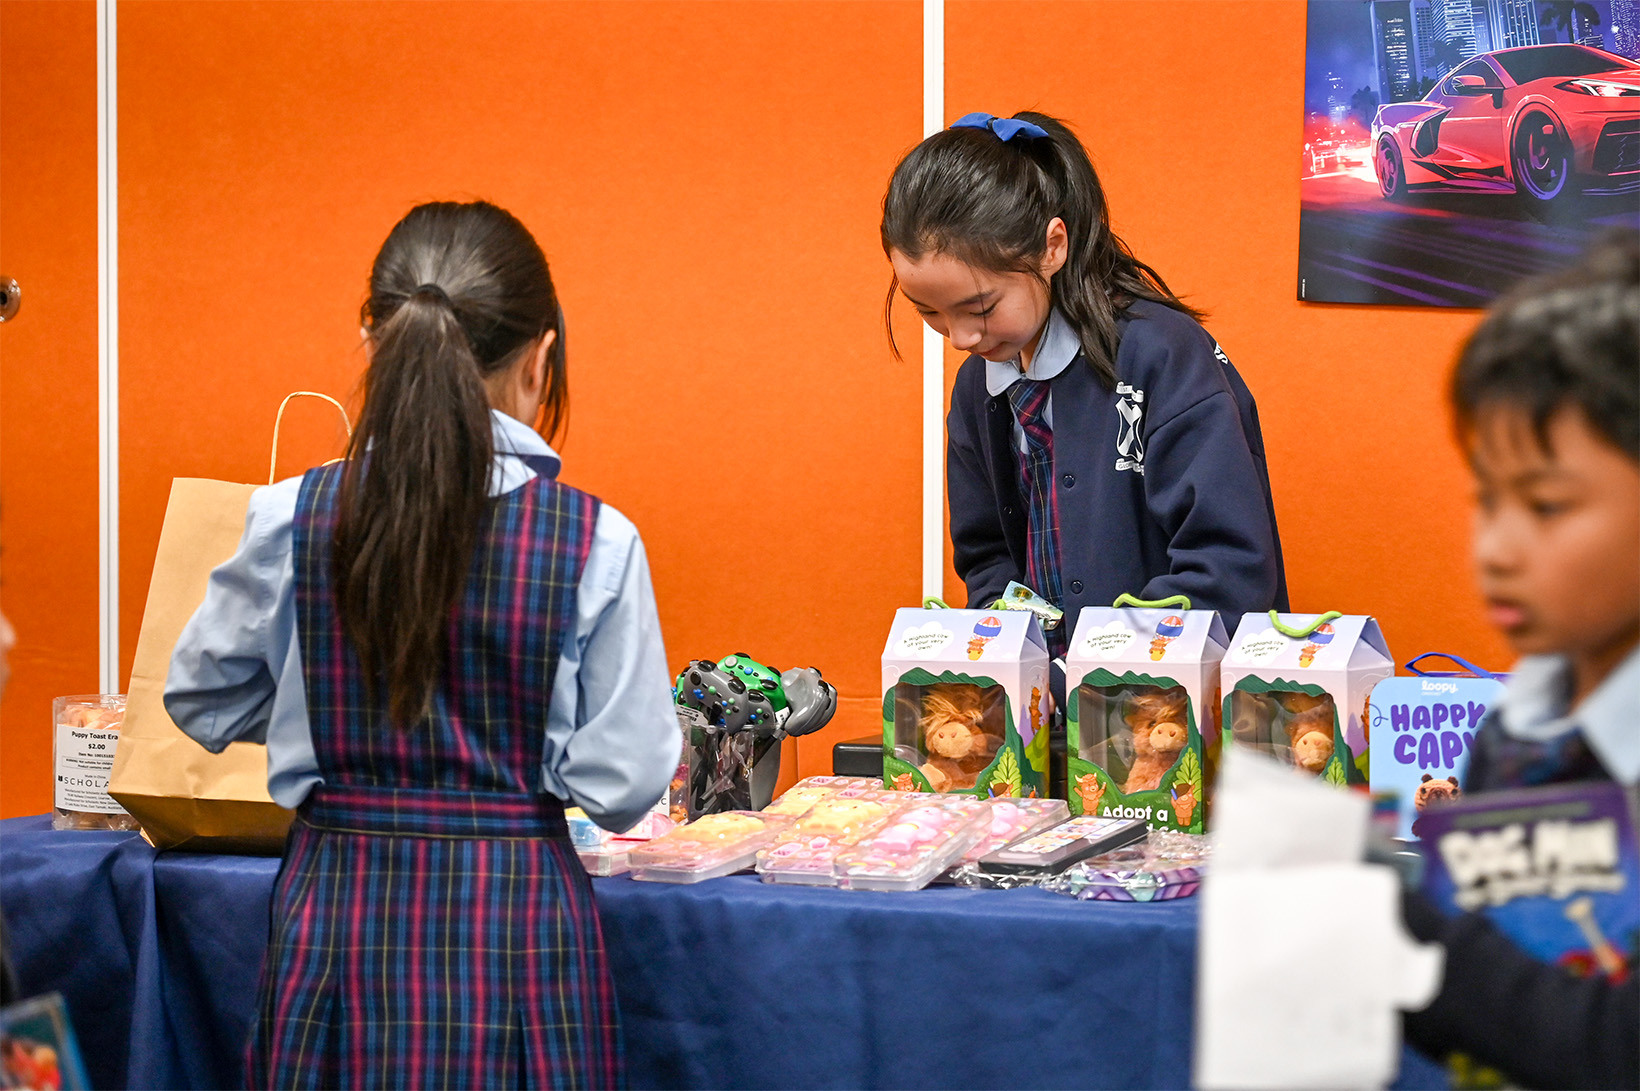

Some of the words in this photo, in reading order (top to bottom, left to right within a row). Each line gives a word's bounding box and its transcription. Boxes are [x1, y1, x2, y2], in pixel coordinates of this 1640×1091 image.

[1390, 700, 1486, 732] HAPPY
[72, 731, 88, 739] Puppy
[64, 777, 109, 788] SCHOLA
[1102, 804, 1152, 820] Adopt
[1156, 809, 1168, 822] a
